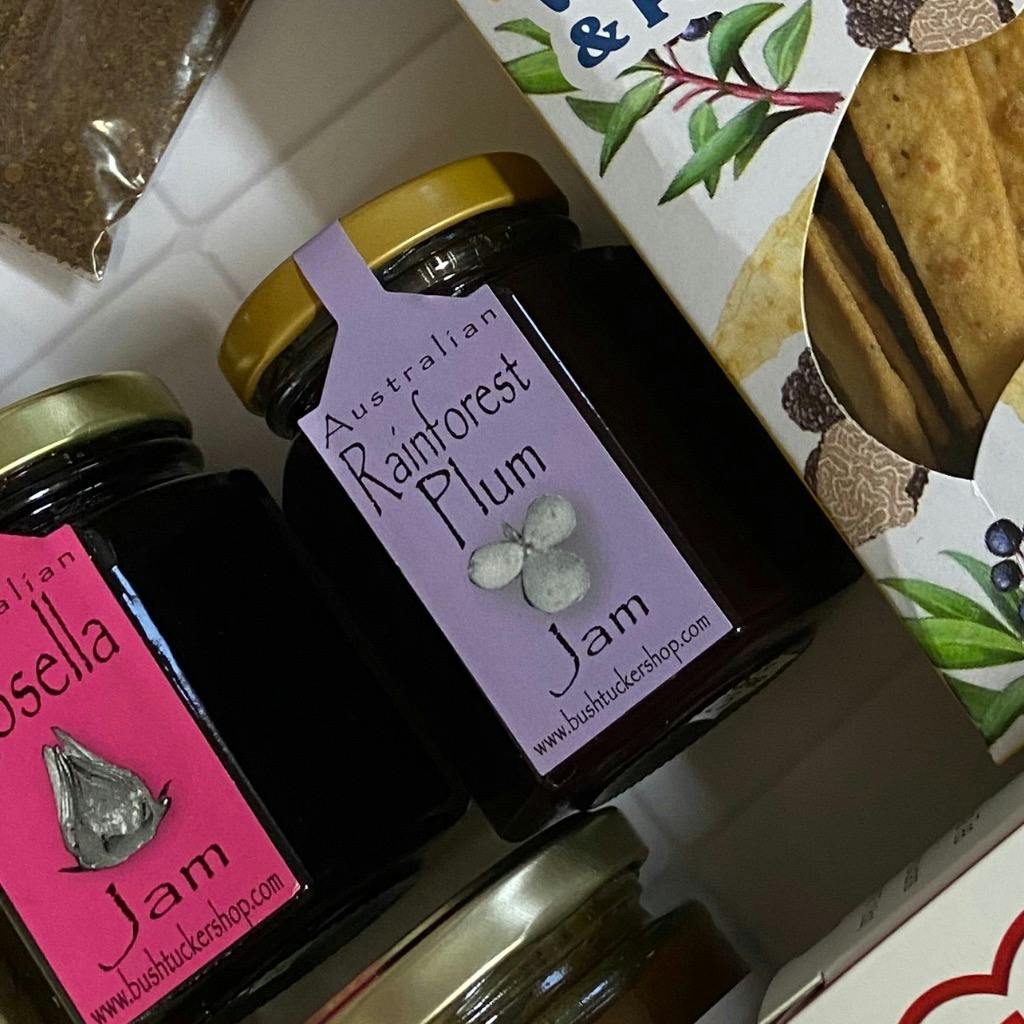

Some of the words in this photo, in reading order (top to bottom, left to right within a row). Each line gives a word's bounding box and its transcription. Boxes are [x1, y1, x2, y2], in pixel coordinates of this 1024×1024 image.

[569, 15, 631, 69] &
[325, 307, 497, 448] Australian
[339, 353, 531, 517] Rainforest
[416, 444, 547, 550] Plum
[533, 613, 711, 757] www.bushtuckershop.com
[549, 593, 650, 699] Jam
[90, 873, 284, 1024] www.bushtuckershop.com
[98, 842, 231, 972] Jam
